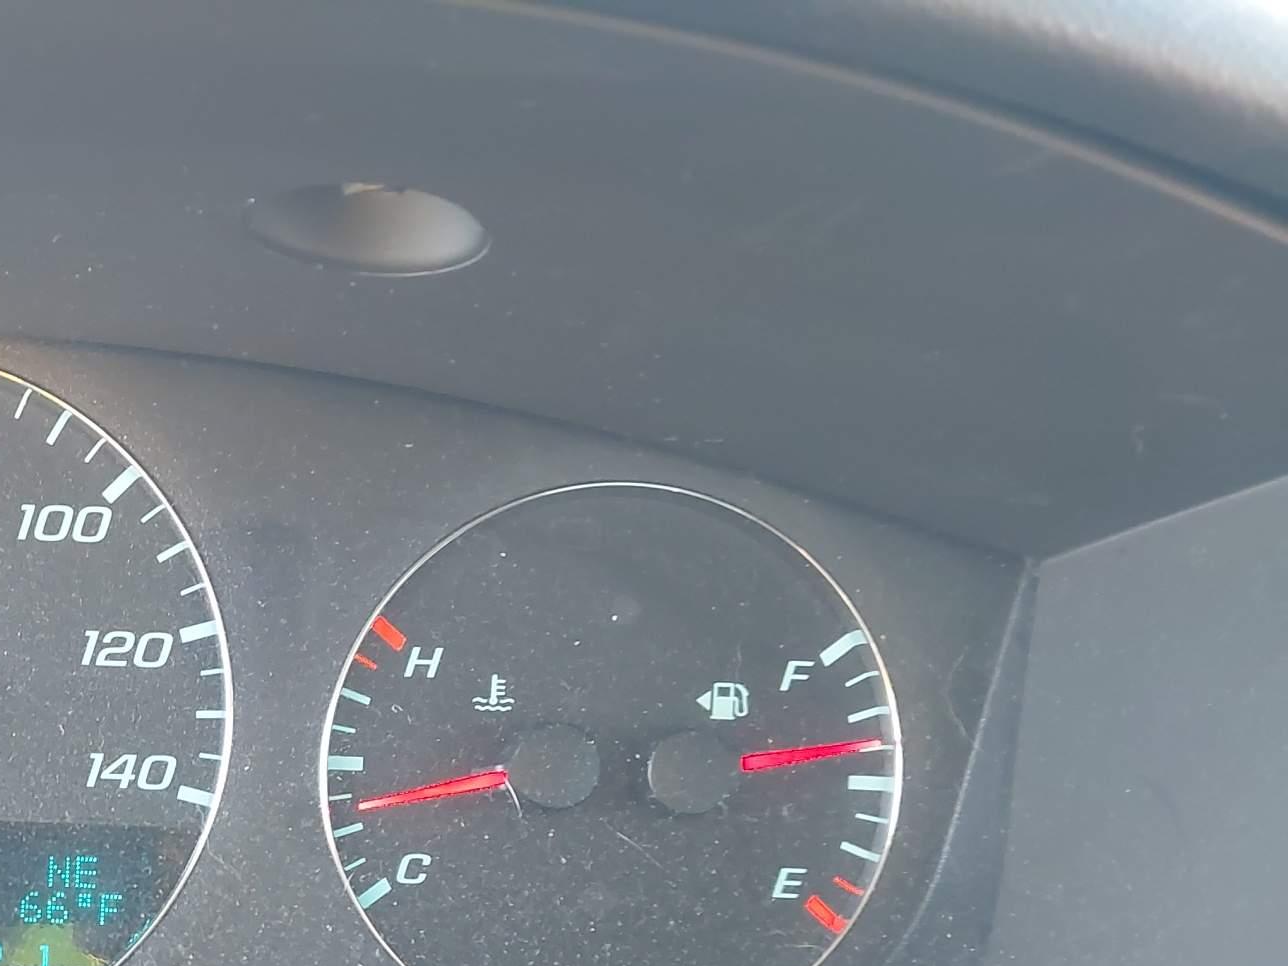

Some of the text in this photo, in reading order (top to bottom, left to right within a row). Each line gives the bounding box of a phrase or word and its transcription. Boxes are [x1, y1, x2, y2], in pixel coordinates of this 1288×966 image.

[17, 503, 112, 543] 100
[81, 629, 172, 669] 120
[403, 647, 444, 678] H
[779, 660, 814, 691] F
[86, 752, 177, 791] 140
[47, 855, 98, 890] NE
[396, 853, 432, 884] C
[771, 867, 808, 899] E
